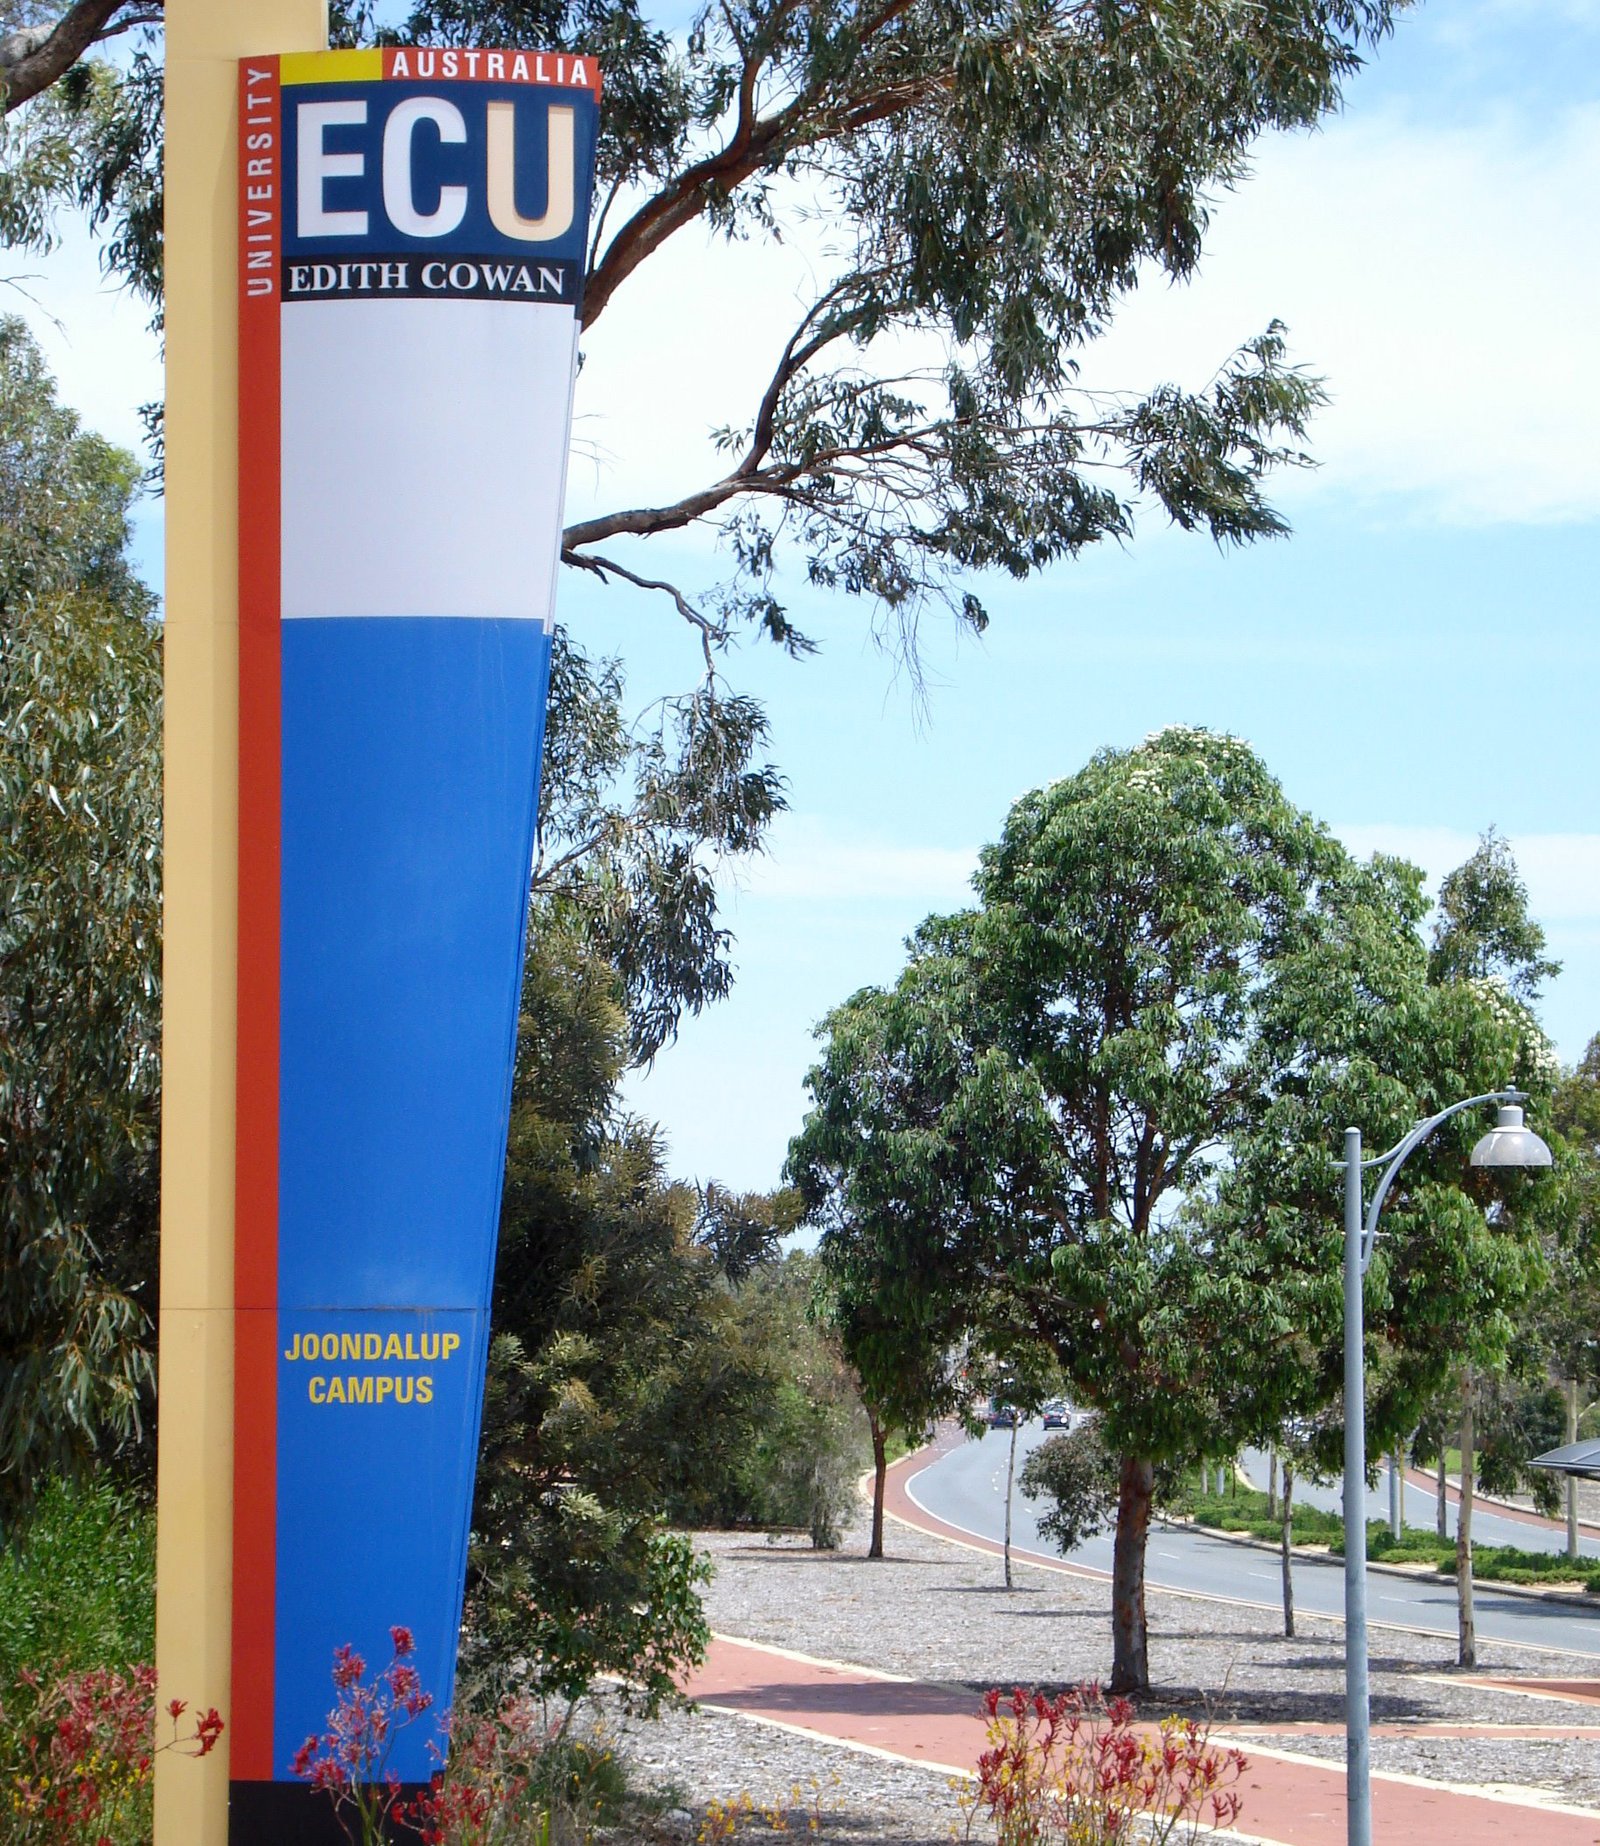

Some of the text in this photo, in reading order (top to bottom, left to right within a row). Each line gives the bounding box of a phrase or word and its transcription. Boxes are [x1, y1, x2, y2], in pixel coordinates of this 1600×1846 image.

[391, 52, 588, 85] AUSTRALIA
[247, 68, 273, 297] UNIVERSITY
[297, 96, 574, 241] ECU
[288, 262, 565, 295] EDITH COWAN
[284, 1333, 461, 1361] JOONDALUP
[308, 1376, 434, 1404] CAMPUS
